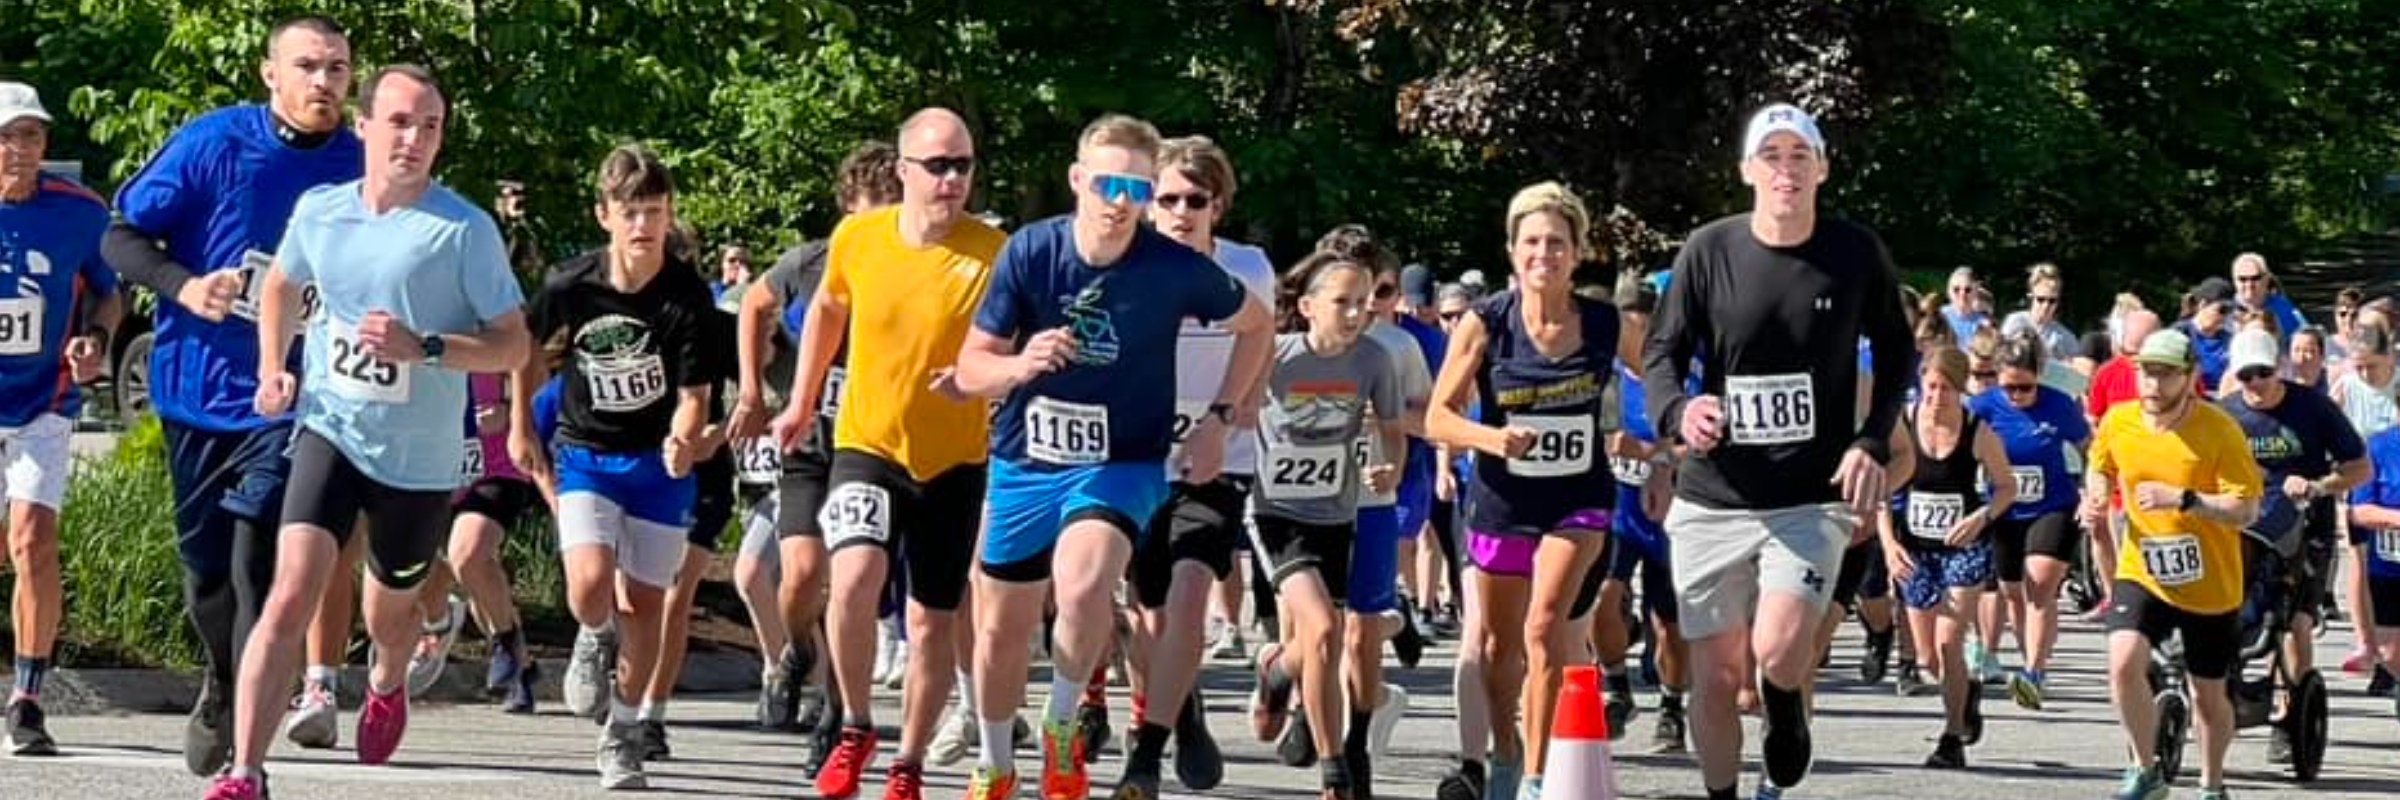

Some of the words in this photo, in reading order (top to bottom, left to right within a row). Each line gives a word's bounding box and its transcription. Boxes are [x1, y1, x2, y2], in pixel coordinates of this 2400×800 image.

[332, 338, 399, 387] 225
[593, 365, 662, 401] 1166
[1732, 389, 1811, 430] 1186
[1030, 412, 1106, 453] 1169
[1274, 458, 1337, 485] 224
[1912, 504, 1961, 530] 1227
[2142, 545, 2200, 576] 1138
